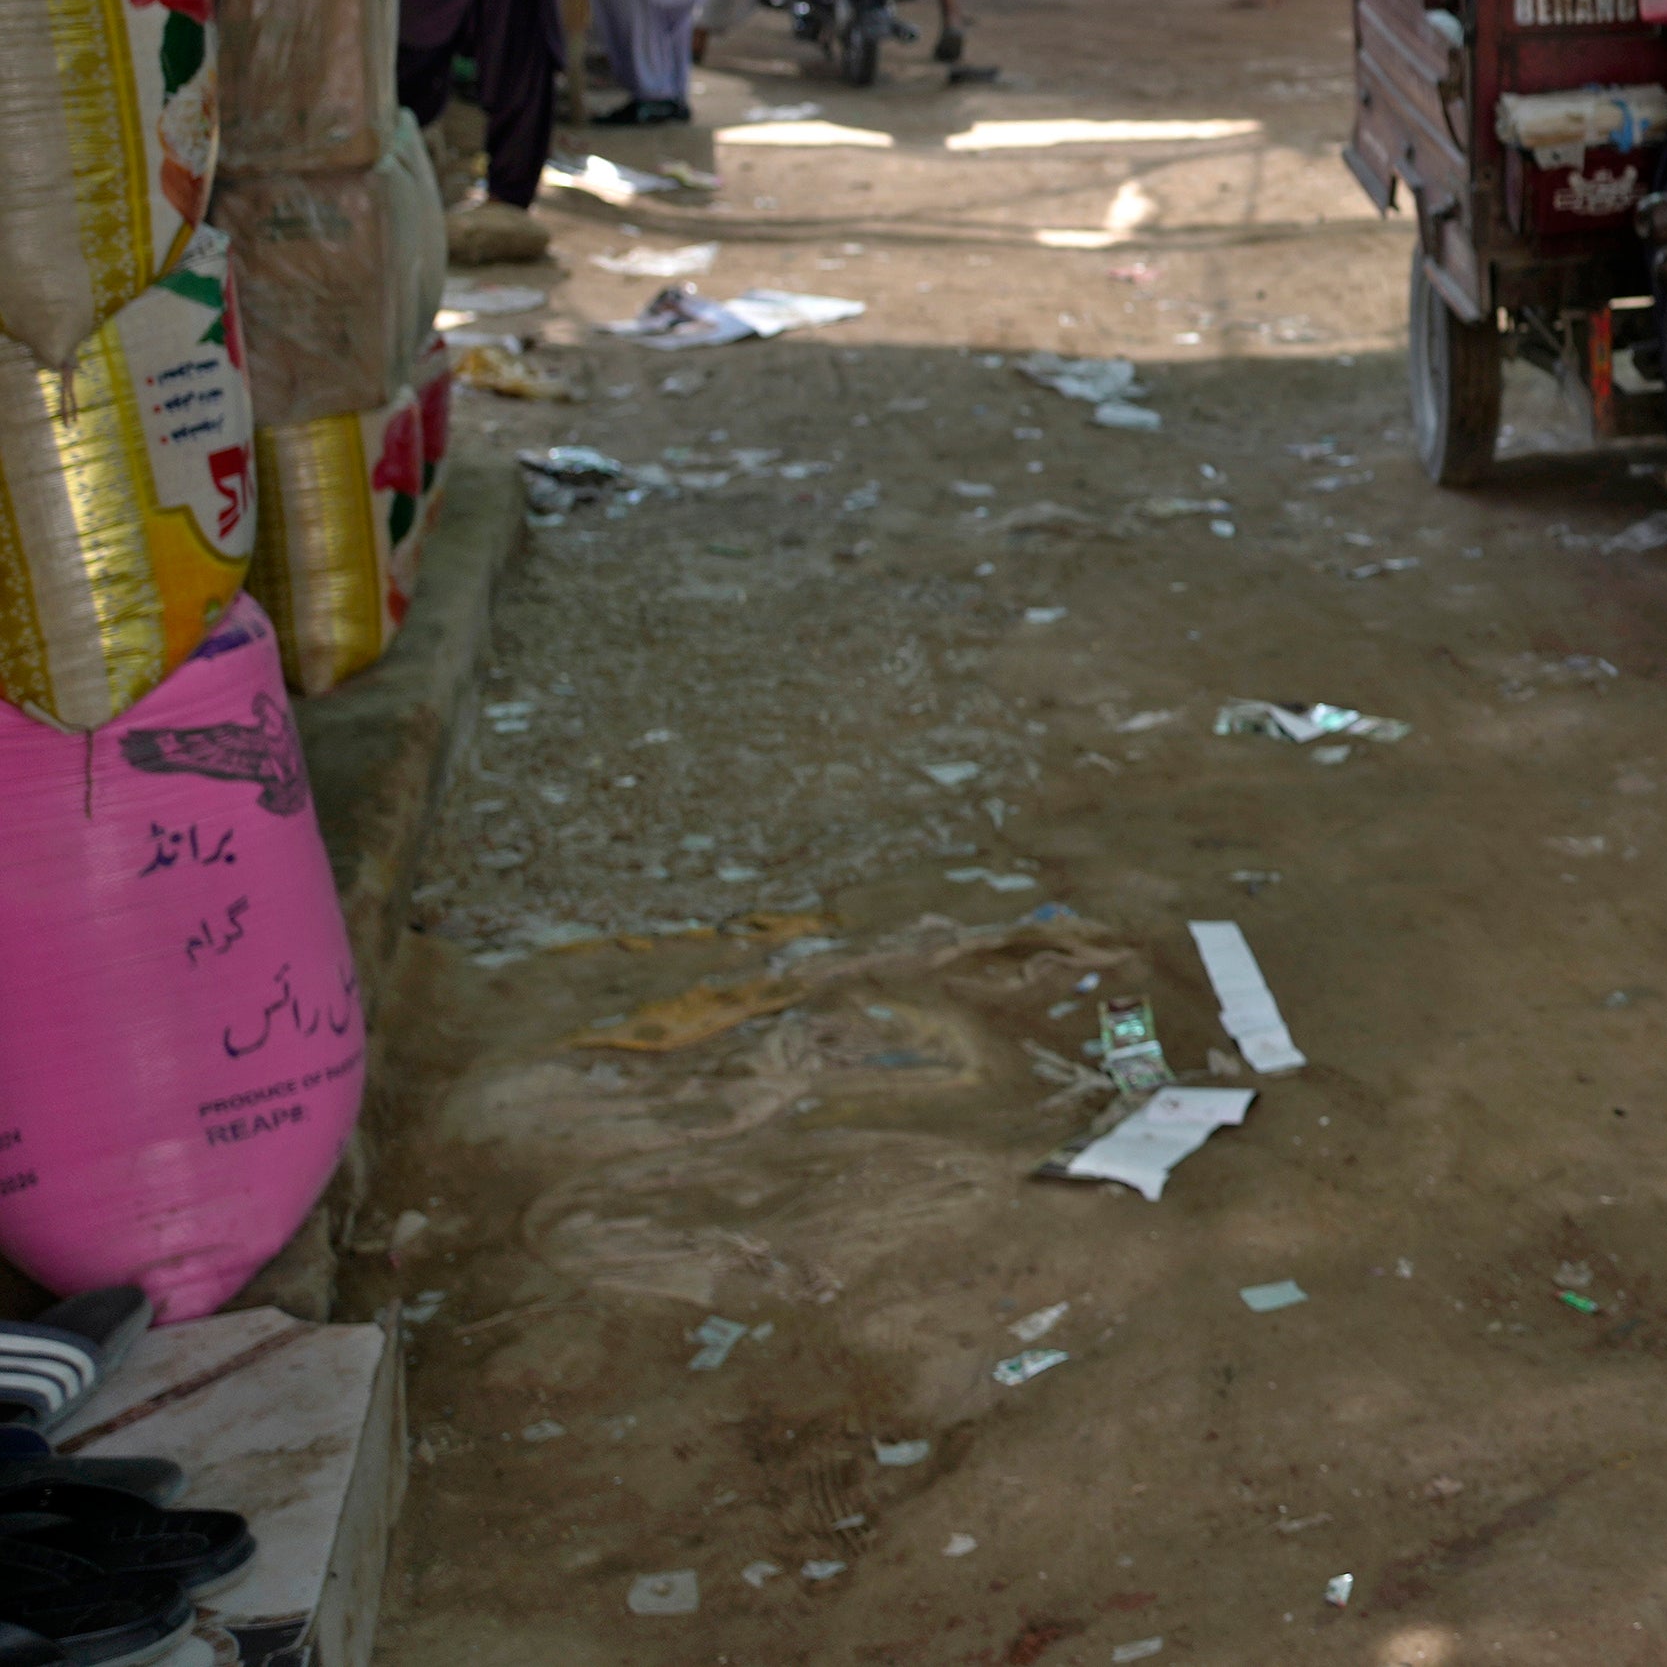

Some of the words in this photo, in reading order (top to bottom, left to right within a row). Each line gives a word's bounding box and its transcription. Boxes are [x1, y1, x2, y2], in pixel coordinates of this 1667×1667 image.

[138, 820, 236, 880] برانڈ
[184, 894, 250, 972] گرام
[222, 964, 322, 1060] رائس
[198, 1079, 298, 1118] PRODUCE
